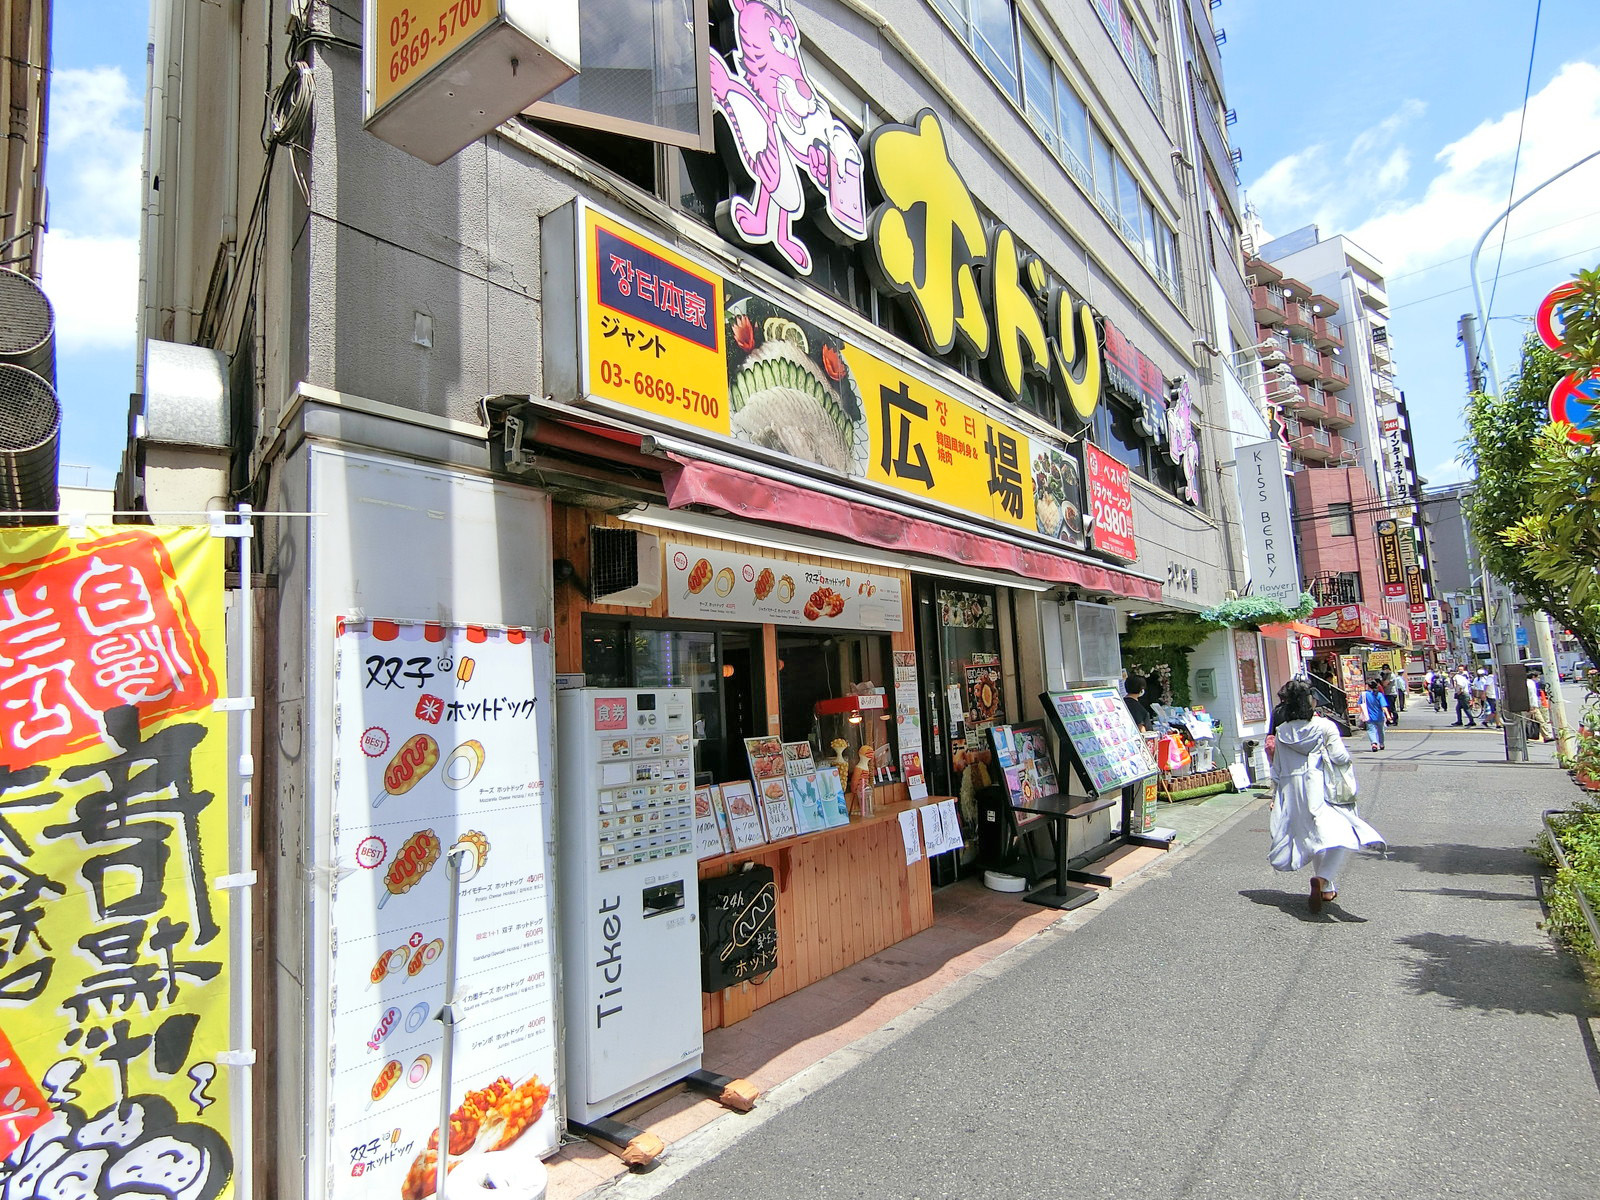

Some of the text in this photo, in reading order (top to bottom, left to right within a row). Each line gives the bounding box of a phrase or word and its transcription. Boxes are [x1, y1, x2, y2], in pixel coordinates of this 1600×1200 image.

[390, 8, 417, 47] 03-
[389, 0, 482, 83] 6869-5700
[870, 109, 1103, 421] ホドリ
[609, 253, 708, 330] 장터本家
[600, 315, 667, 359] ジャント
[1384, 421, 1398, 430] 24H
[936, 448, 954, 467] 焼肉
[1104, 465, 1121, 487] ベスト
[1091, 480, 1131, 511] リラクゼーション
[1253, 450, 1277, 578] KISS BERRY
[1260, 582, 1292, 592] flower
[1267, 590, 1285, 599] cafe
[365, 654, 435, 690] 双子
[446, 696, 538, 723] ホットドッグ
[598, 703, 625, 723] 食券
[364, 735, 385, 749] BEST
[479, 787, 494, 795] チーズ
[497, 783, 525, 793] ホットドッグ
[360, 846, 383, 859] BEST
[495, 878, 524, 890] ホットドッグ
[722, 890, 745, 910] 24h
[515, 917, 544, 931] ホットドッグ
[525, 926, 544, 939] 600円
[596, 895, 623, 1029] Ticket
[495, 977, 525, 993] ホットドッグ
[527, 971, 545, 983] 400円
[495, 1025, 525, 1040] ホットドッグ
[527, 1016, 546, 1028] 400円
[350, 1137, 381, 1165] 双子
[366, 1140, 414, 1173] ホットドッグ
